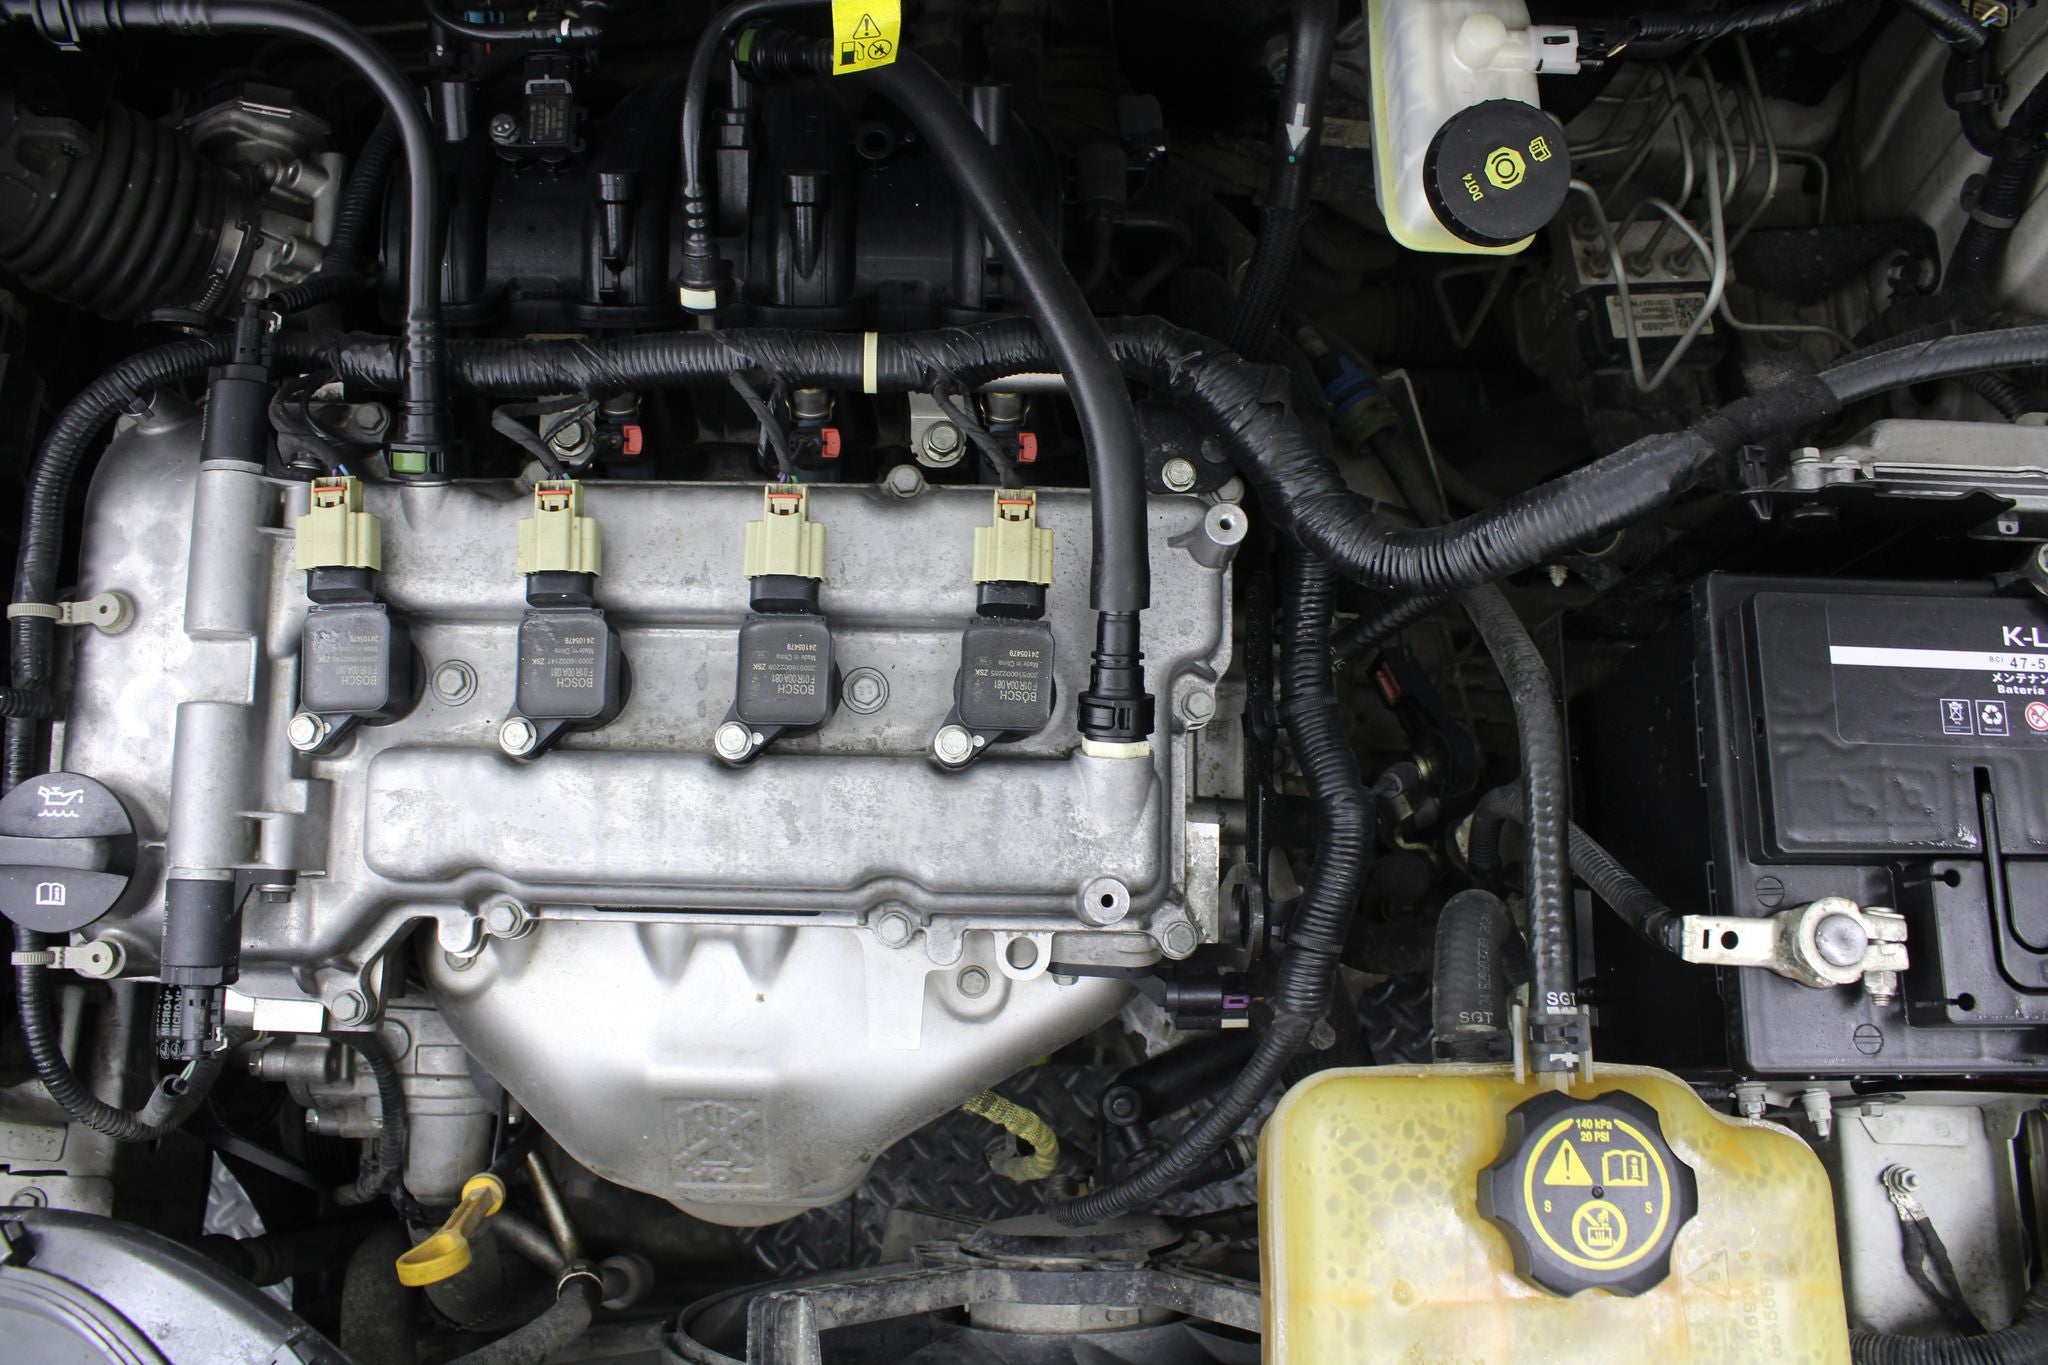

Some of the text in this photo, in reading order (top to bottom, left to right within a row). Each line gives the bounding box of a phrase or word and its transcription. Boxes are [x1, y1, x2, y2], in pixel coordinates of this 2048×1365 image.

[786, 643, 817, 651] 24105479
[1009, 649, 1039, 658] 24105479
[2010, 656, 2048, 670] 47-5
[975, 668, 988, 676] ZSK
[341, 675, 377, 685] BOSCH
[556, 677, 593, 687] BOSCH
[778, 684, 815, 695] BOSCH
[1000, 690, 1037, 703] BOSCH
[1546, 991, 1576, 1006] SGT
[1458, 1011, 1494, 1024] SGT
[1576, 1119, 1612, 1130] 140 kPa
[1580, 1131, 1610, 1142] 20 PSI
